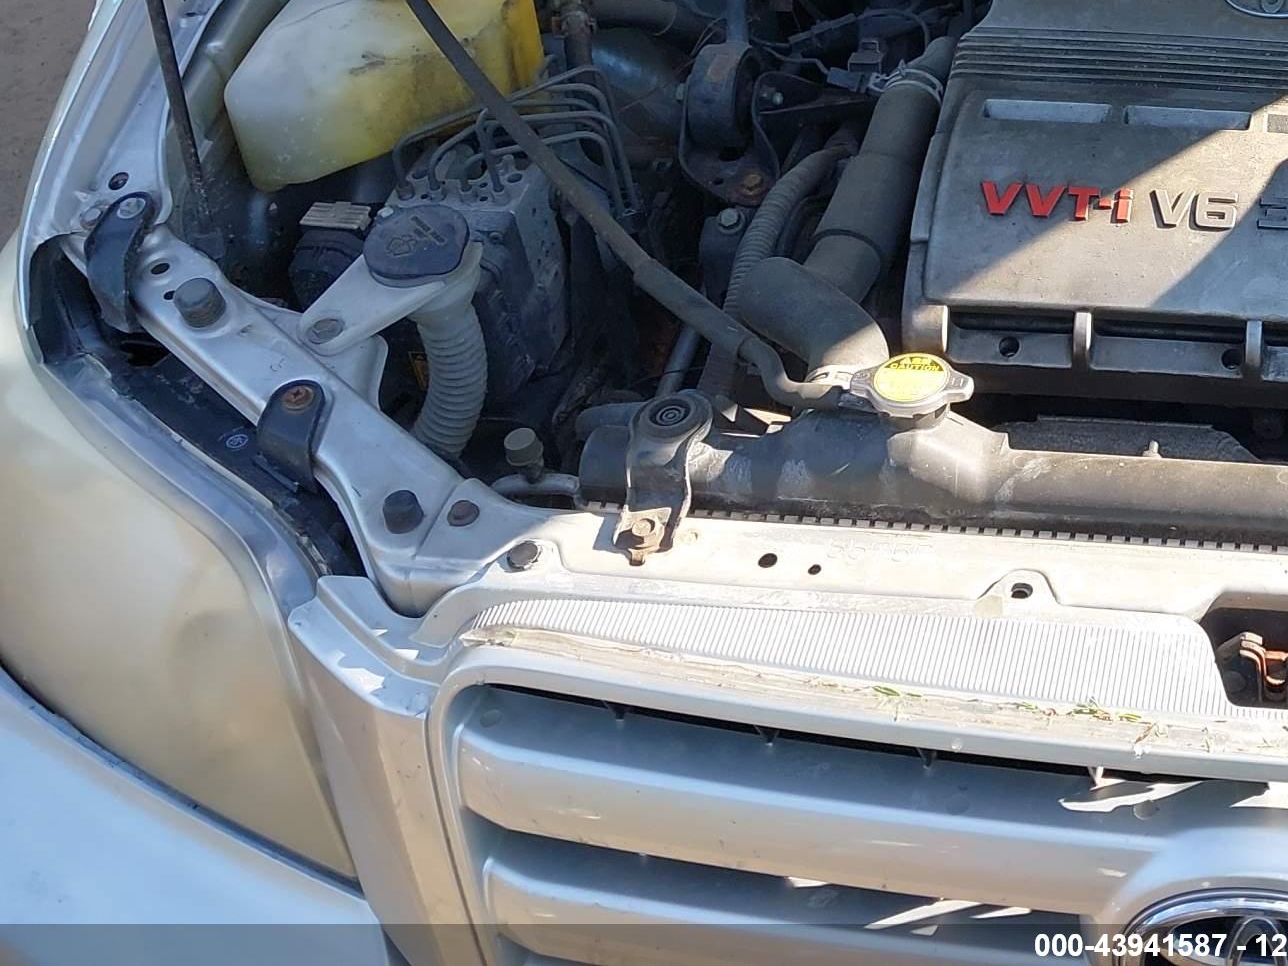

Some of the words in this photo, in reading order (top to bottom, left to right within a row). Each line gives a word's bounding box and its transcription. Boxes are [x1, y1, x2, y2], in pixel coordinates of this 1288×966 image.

[981, 180, 1134, 224] VVT-i
[1150, 189, 1239, 232] V6
[890, 362, 941, 371] CAUTION
